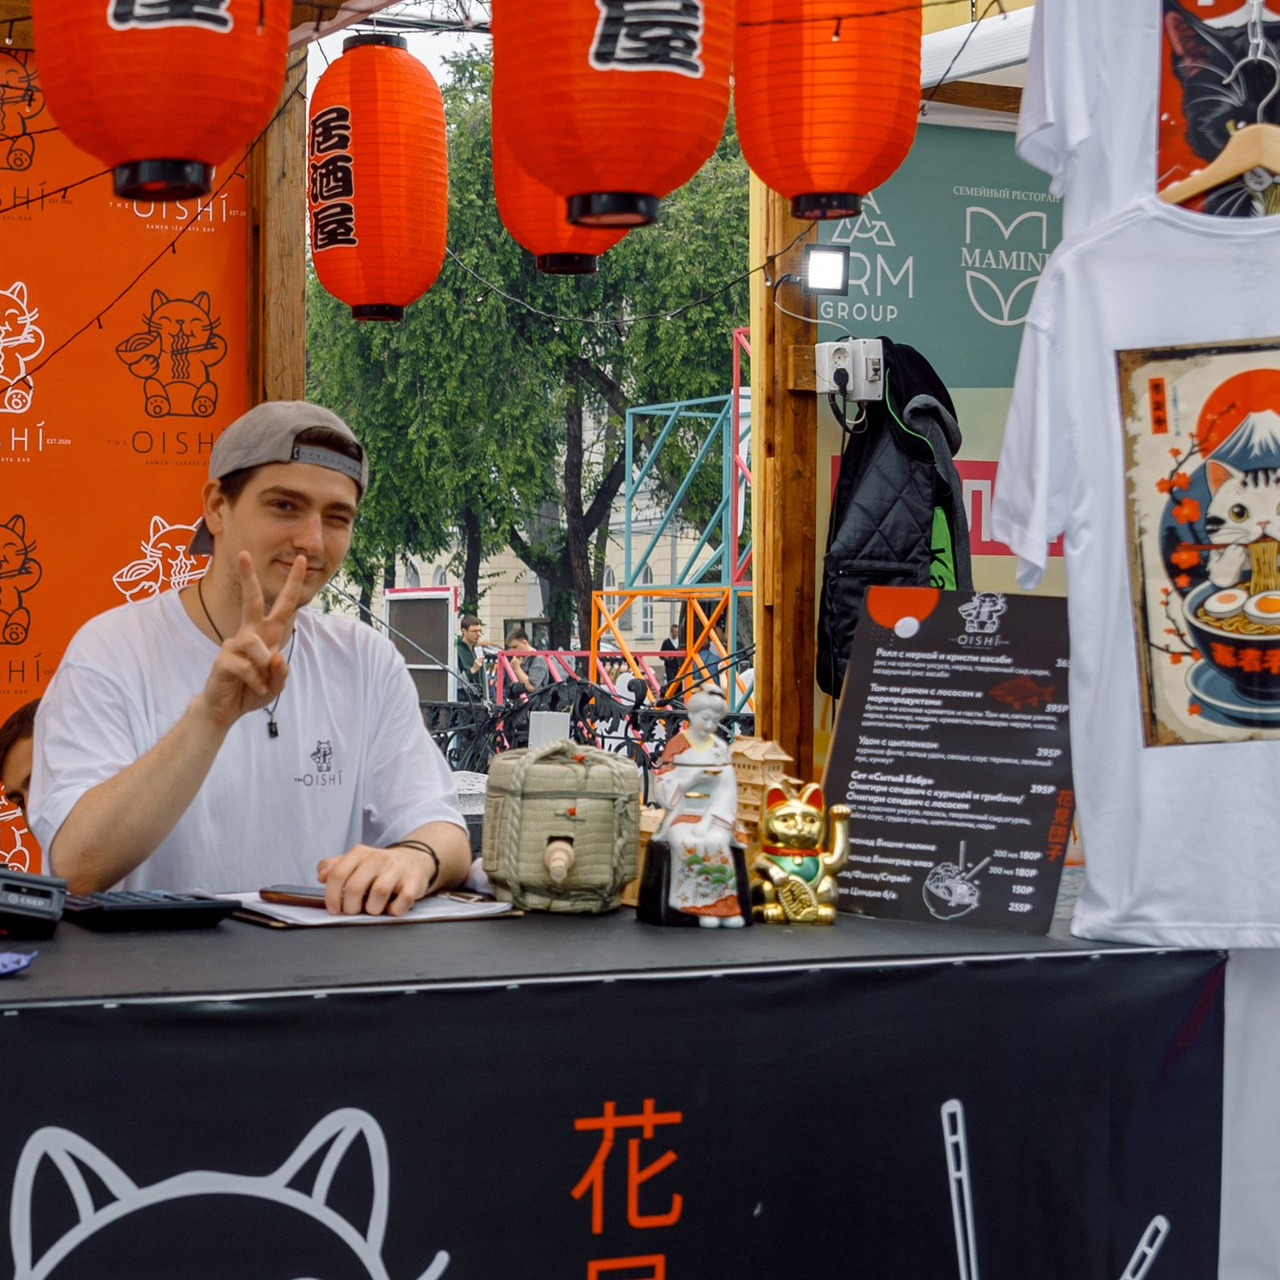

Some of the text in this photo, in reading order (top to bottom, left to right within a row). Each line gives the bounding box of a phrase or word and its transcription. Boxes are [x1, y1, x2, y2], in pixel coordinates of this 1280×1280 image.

[309, 105, 359, 252] 居酒屋
[952, 185, 1010, 201] СЕМЕЙНЫЙ
[821, 301, 898, 322] GROUP
[132, 431, 213, 454] OISH
[876, 648, 897, 657] Ролл
[905, 651, 937, 660] неркой
[946, 654, 978, 662] криспи
[980, 654, 1012, 663] васаби
[870, 683, 900, 693] Том-ям
[901, 686, 928, 695] рамен
[937, 689, 974, 697] лососем
[867, 695, 942, 706] морепродуктами
[858, 736, 880, 745] Удон
[888, 739, 939, 749] цыпленком
[303, 771, 342, 786] OISHÍ
[851, 770, 867, 779] Сет
[848, 781, 887, 792] Онигири
[889, 786, 926, 796] сендвич
[934, 790, 971, 800] курицей
[846, 791, 885, 804] Онигири
[887, 796, 923, 807] сендвич
[932, 800, 970, 810] лососем
[850, 887, 881, 898] Циндао
